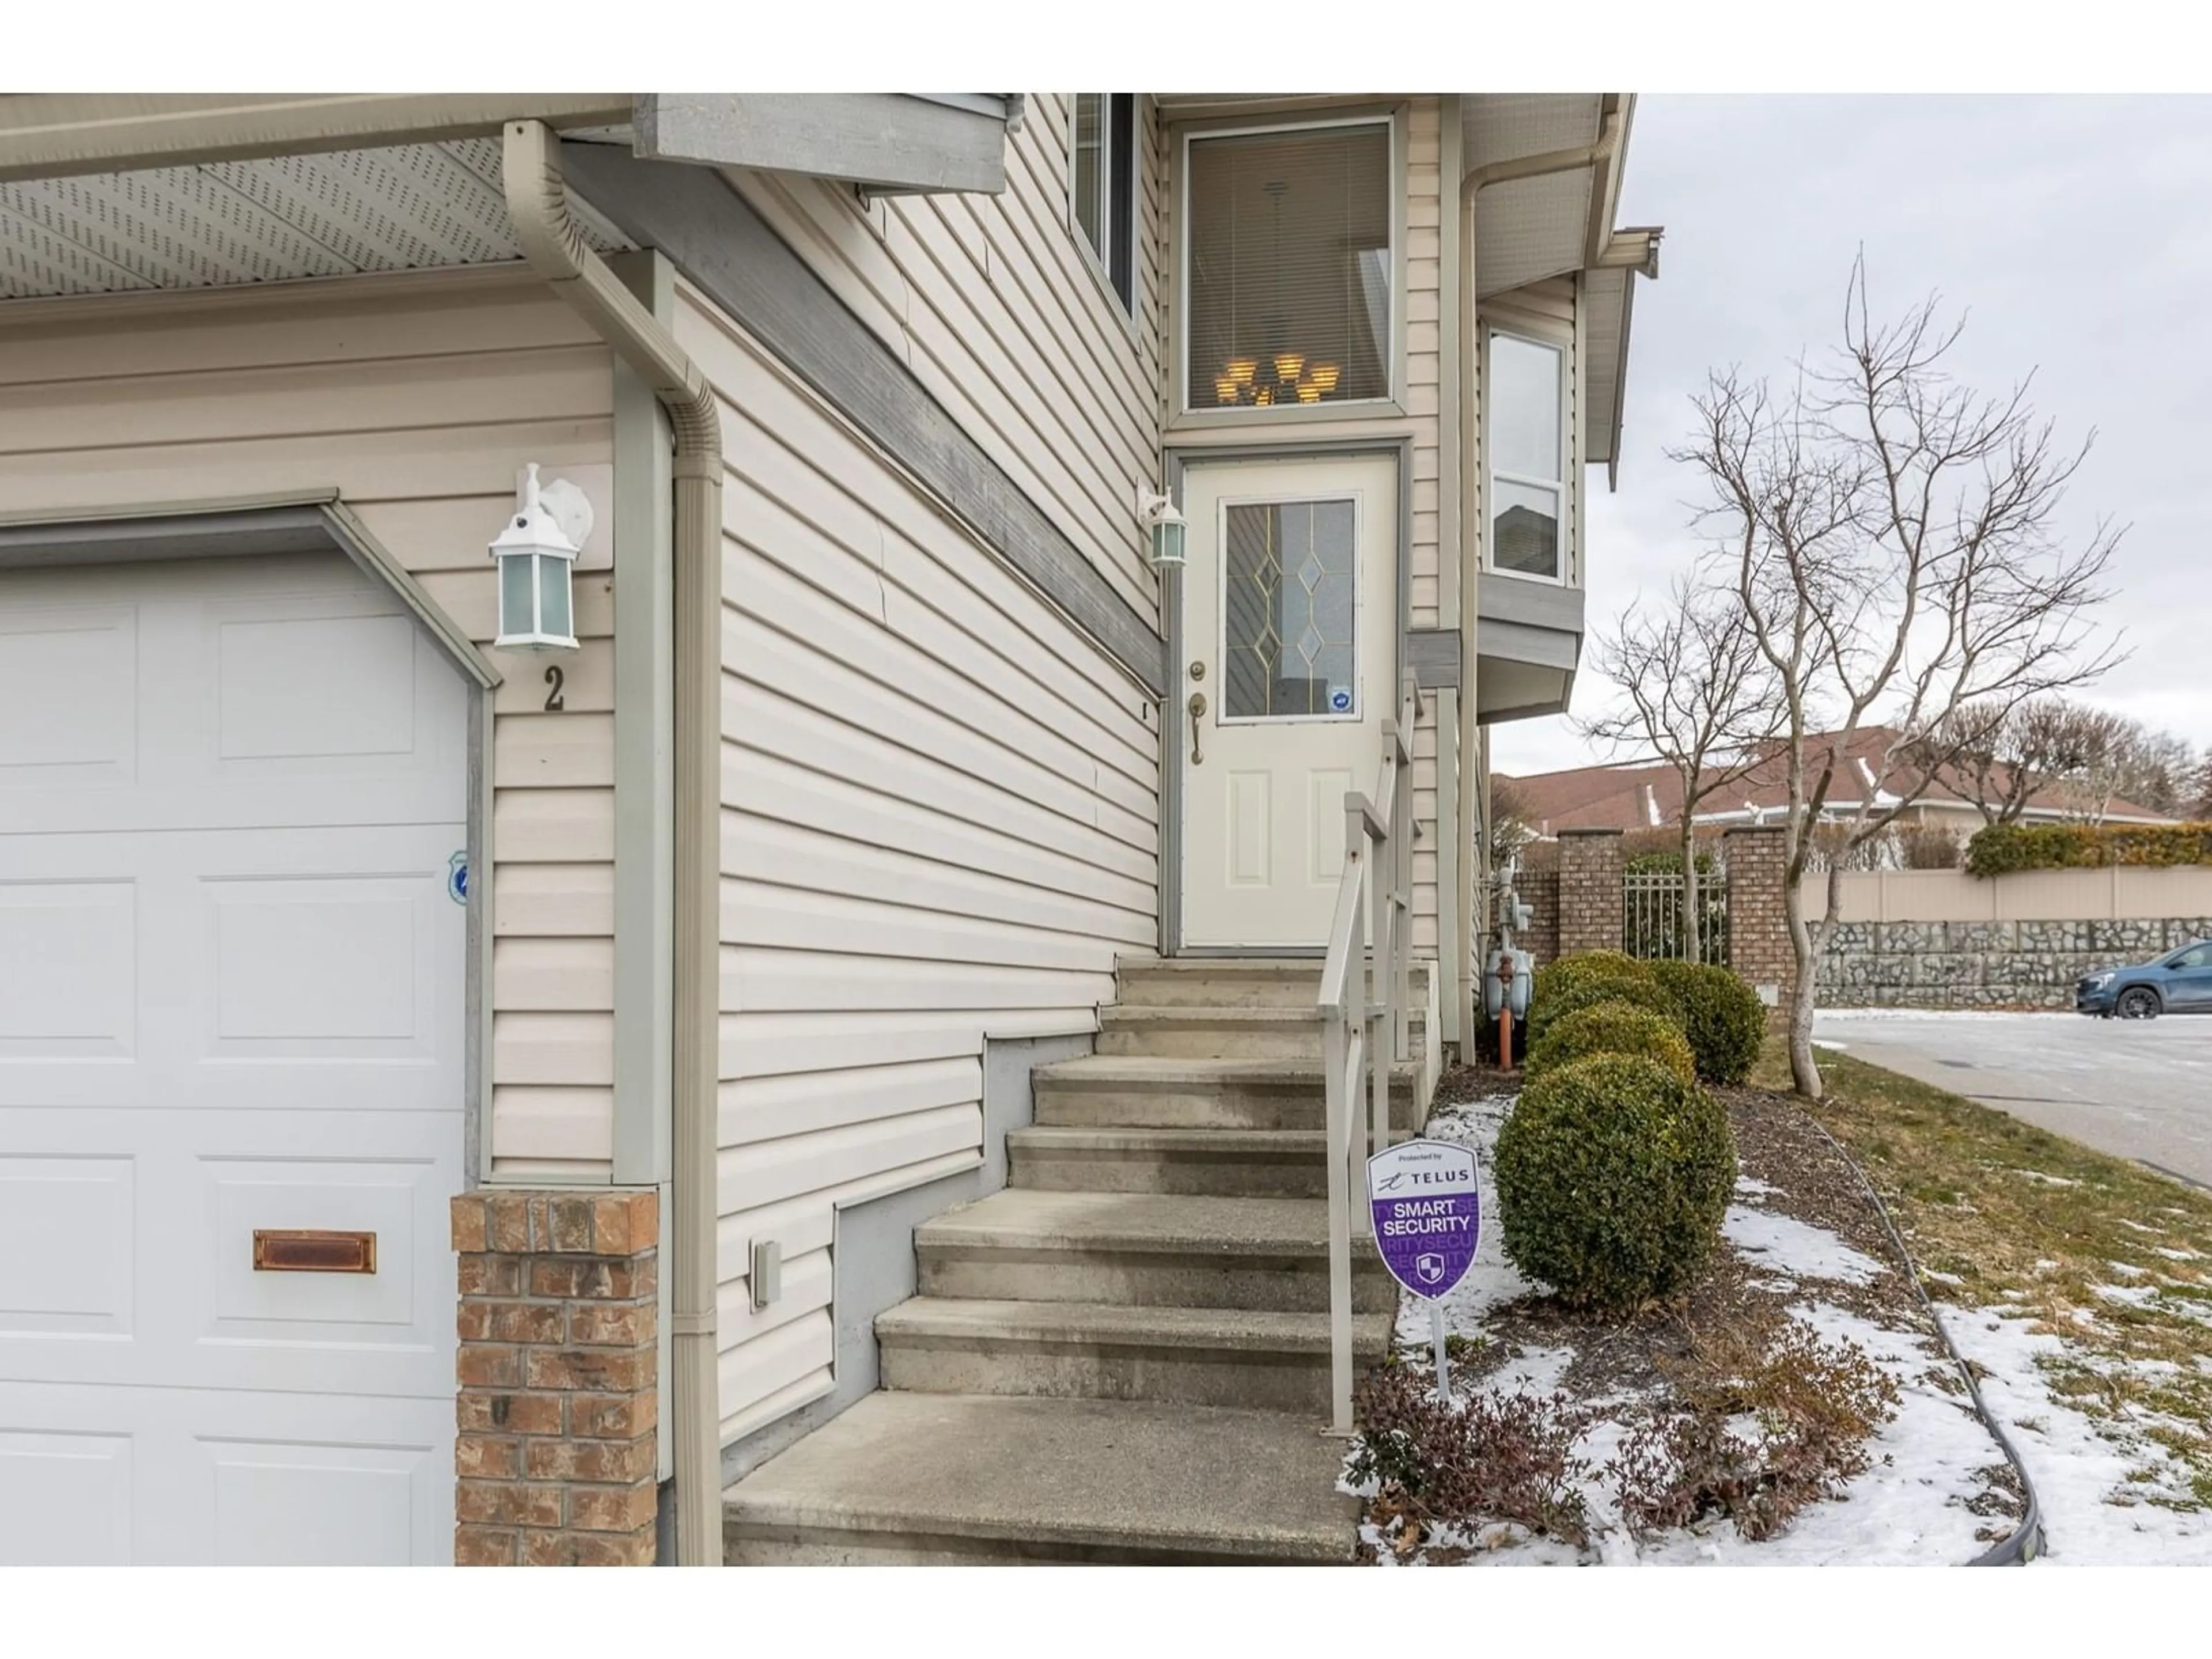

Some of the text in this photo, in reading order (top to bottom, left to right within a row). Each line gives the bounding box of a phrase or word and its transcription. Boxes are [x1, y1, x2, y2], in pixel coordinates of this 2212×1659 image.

[544, 664, 564, 711] 2
[1399, 1153, 1442, 1161] Protected by
[1411, 1169, 1468, 1184] TELUS
[1394, 1200, 1455, 1218] SMART
[1384, 1216, 1471, 1236] SECURITY
